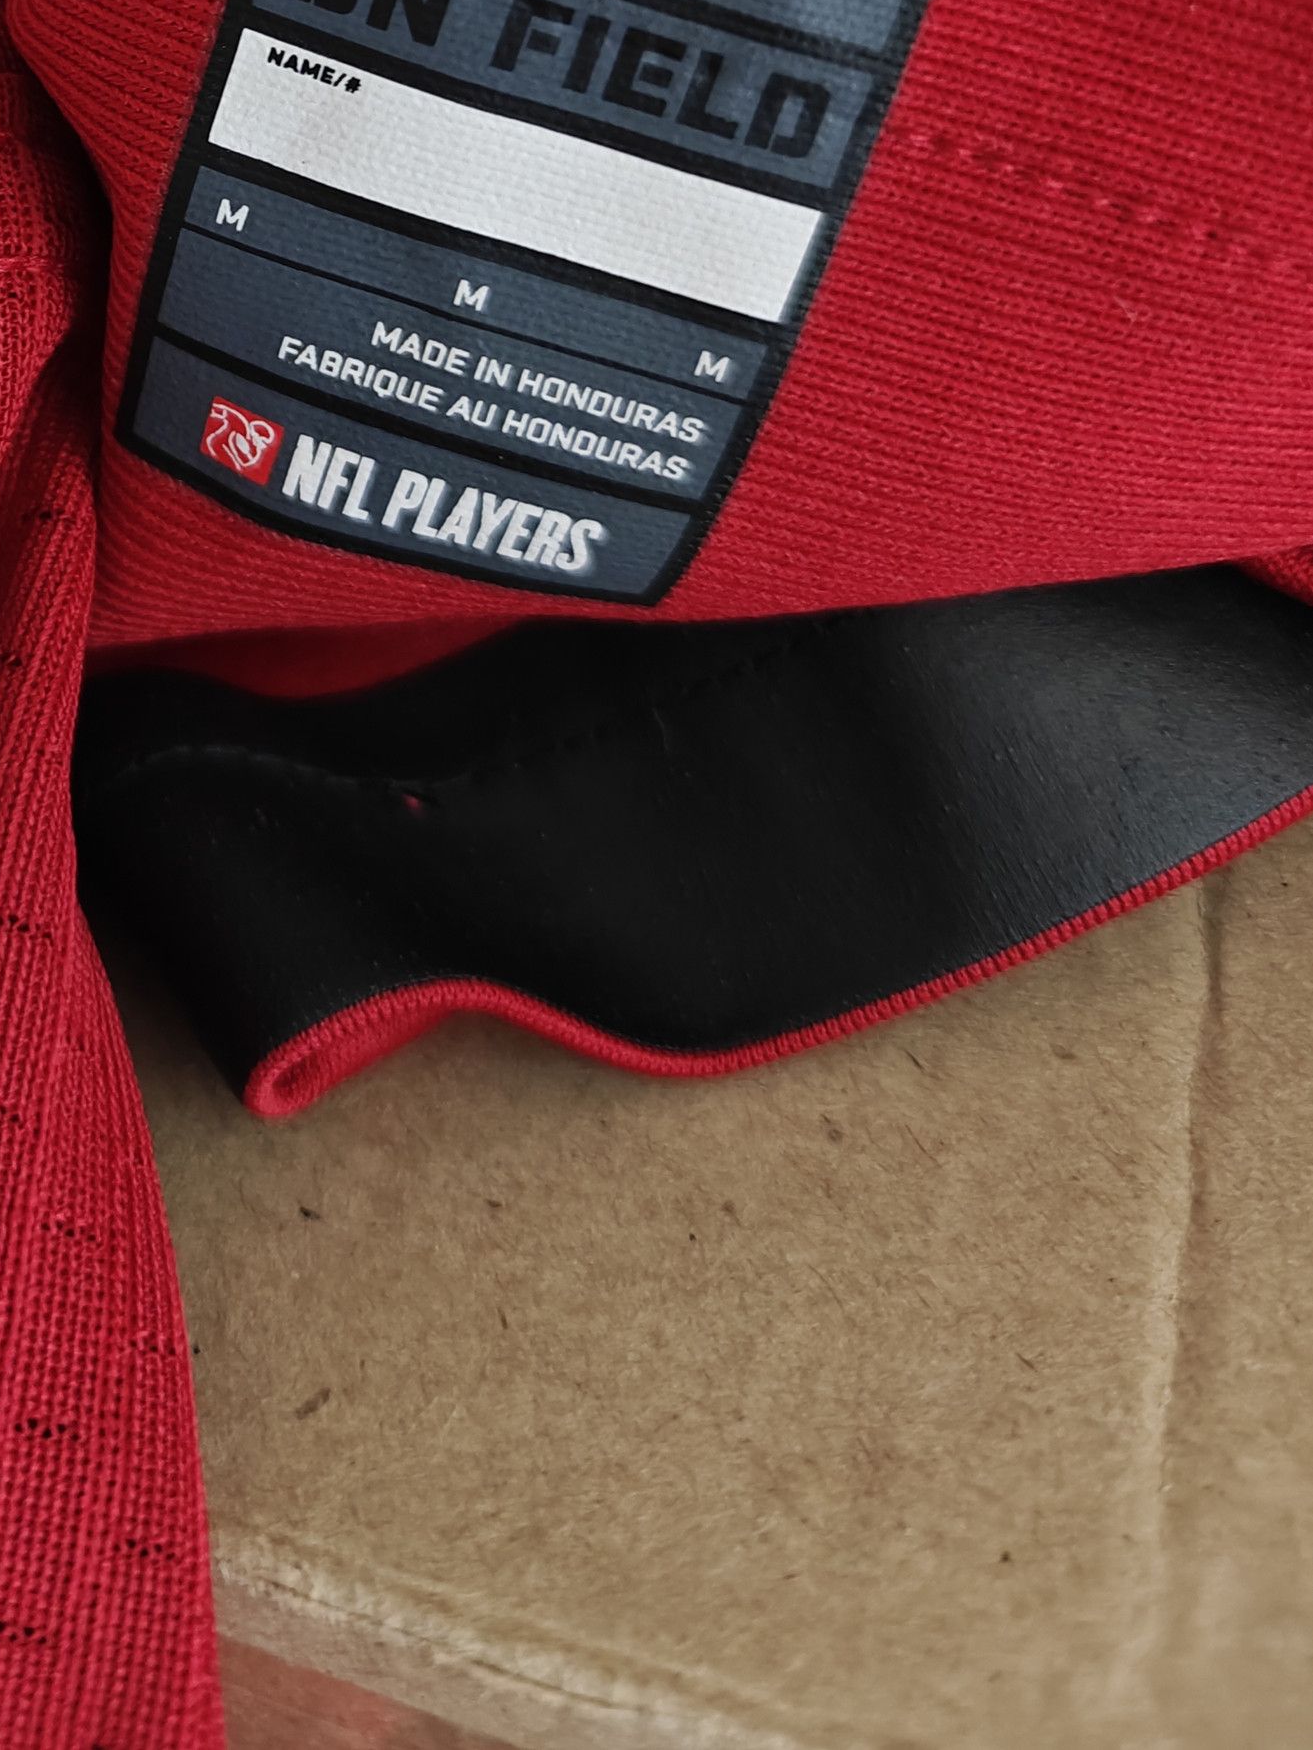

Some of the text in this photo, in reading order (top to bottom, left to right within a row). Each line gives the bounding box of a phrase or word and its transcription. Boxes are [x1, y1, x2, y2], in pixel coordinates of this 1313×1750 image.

[267, 46, 363, 94] NAME/#
[215, 197, 733, 385] M M M
[276, 335, 691, 482] FABRIQUE AU HONDURAS
[370, 321, 708, 444] MADE IN HONDURAS
[282, 433, 606, 572] NFL PLAYERS
